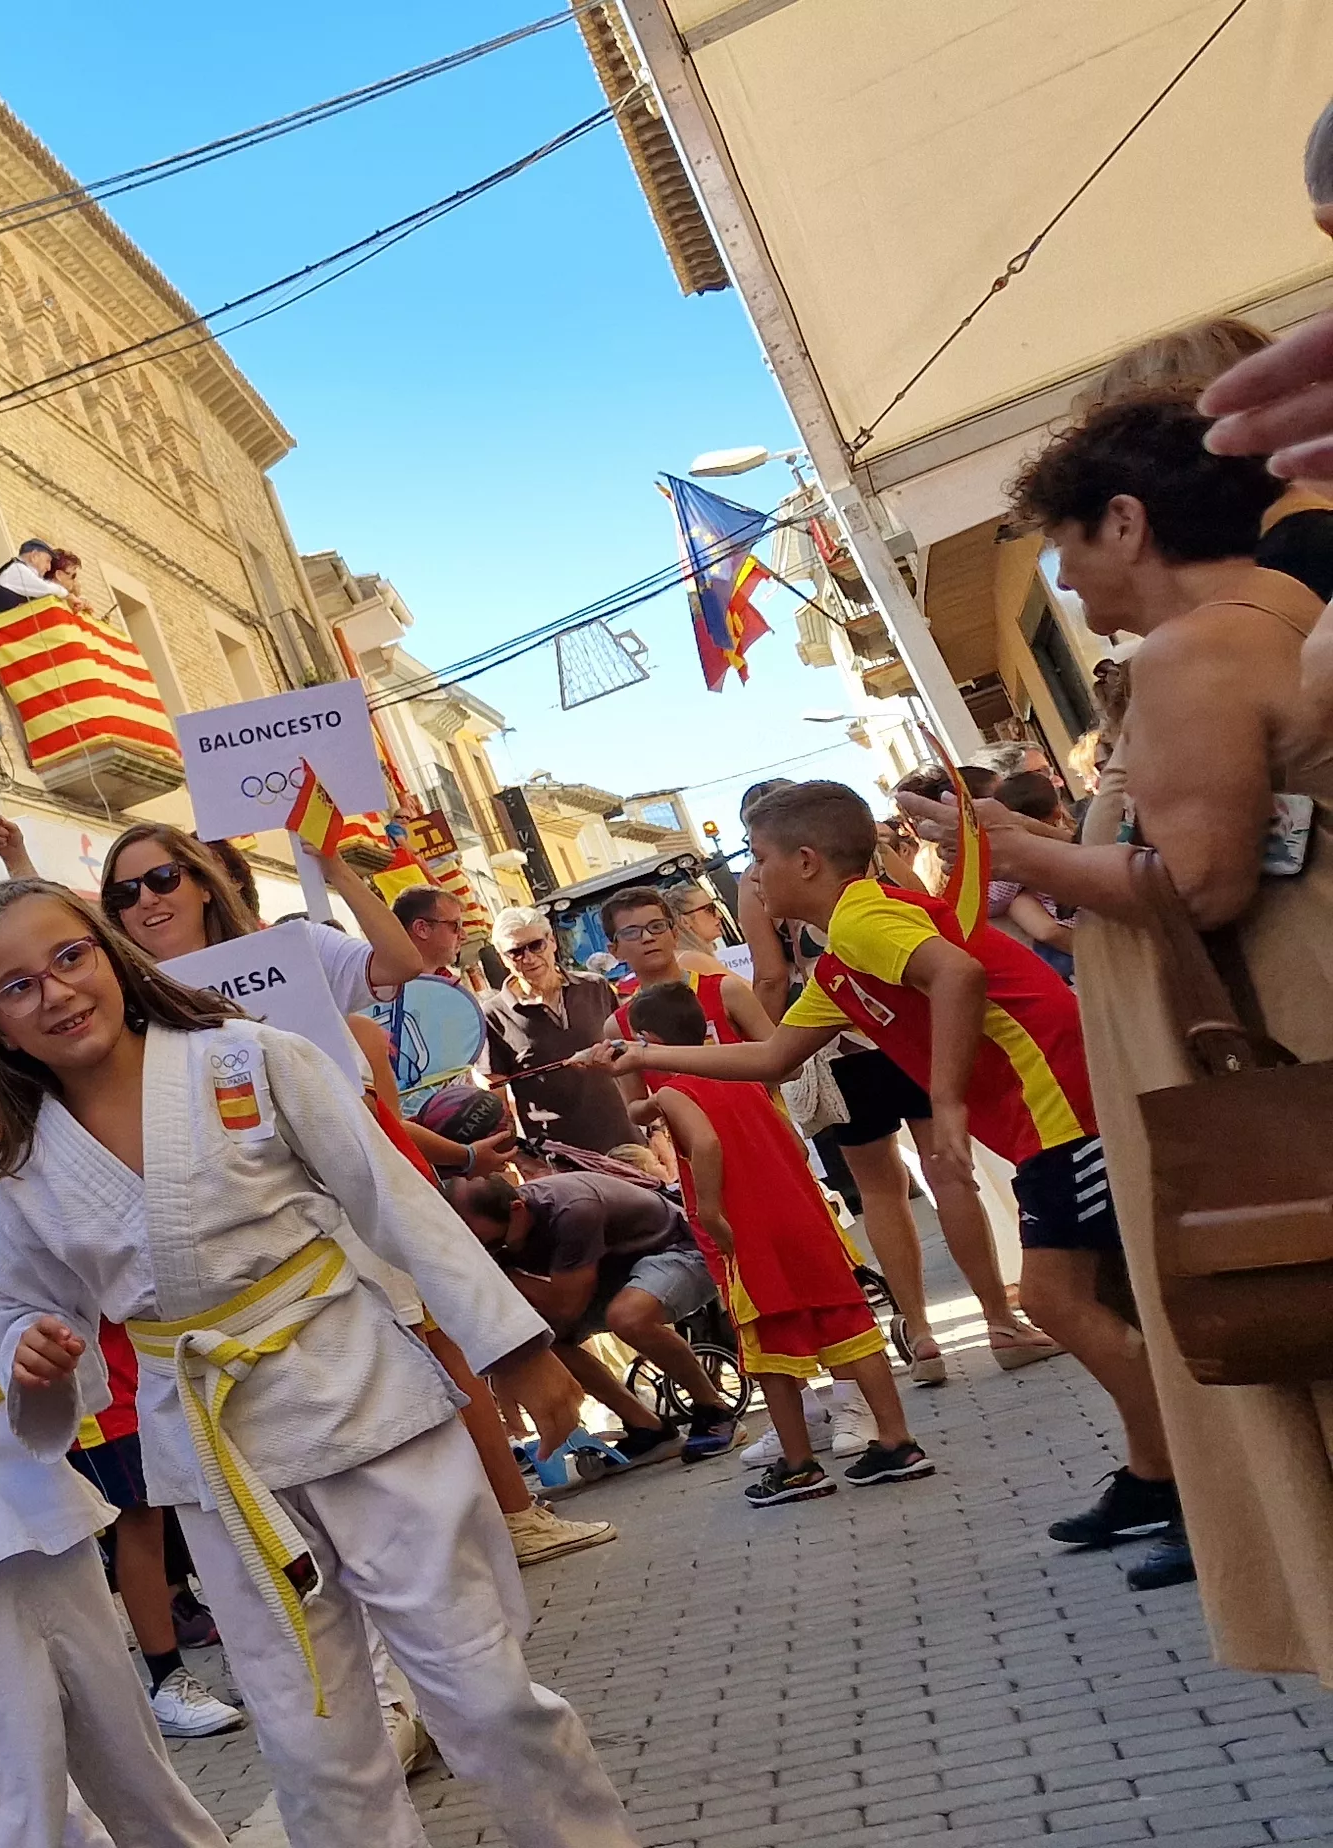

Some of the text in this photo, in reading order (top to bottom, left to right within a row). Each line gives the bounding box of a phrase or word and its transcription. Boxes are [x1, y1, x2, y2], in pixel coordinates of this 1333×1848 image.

[198, 709, 343, 754] BALONCESTO
[420, 842, 454, 859] ACOS
[208, 966, 287, 999] MESA
[216, 1075, 250, 1088] ESPAÑA
